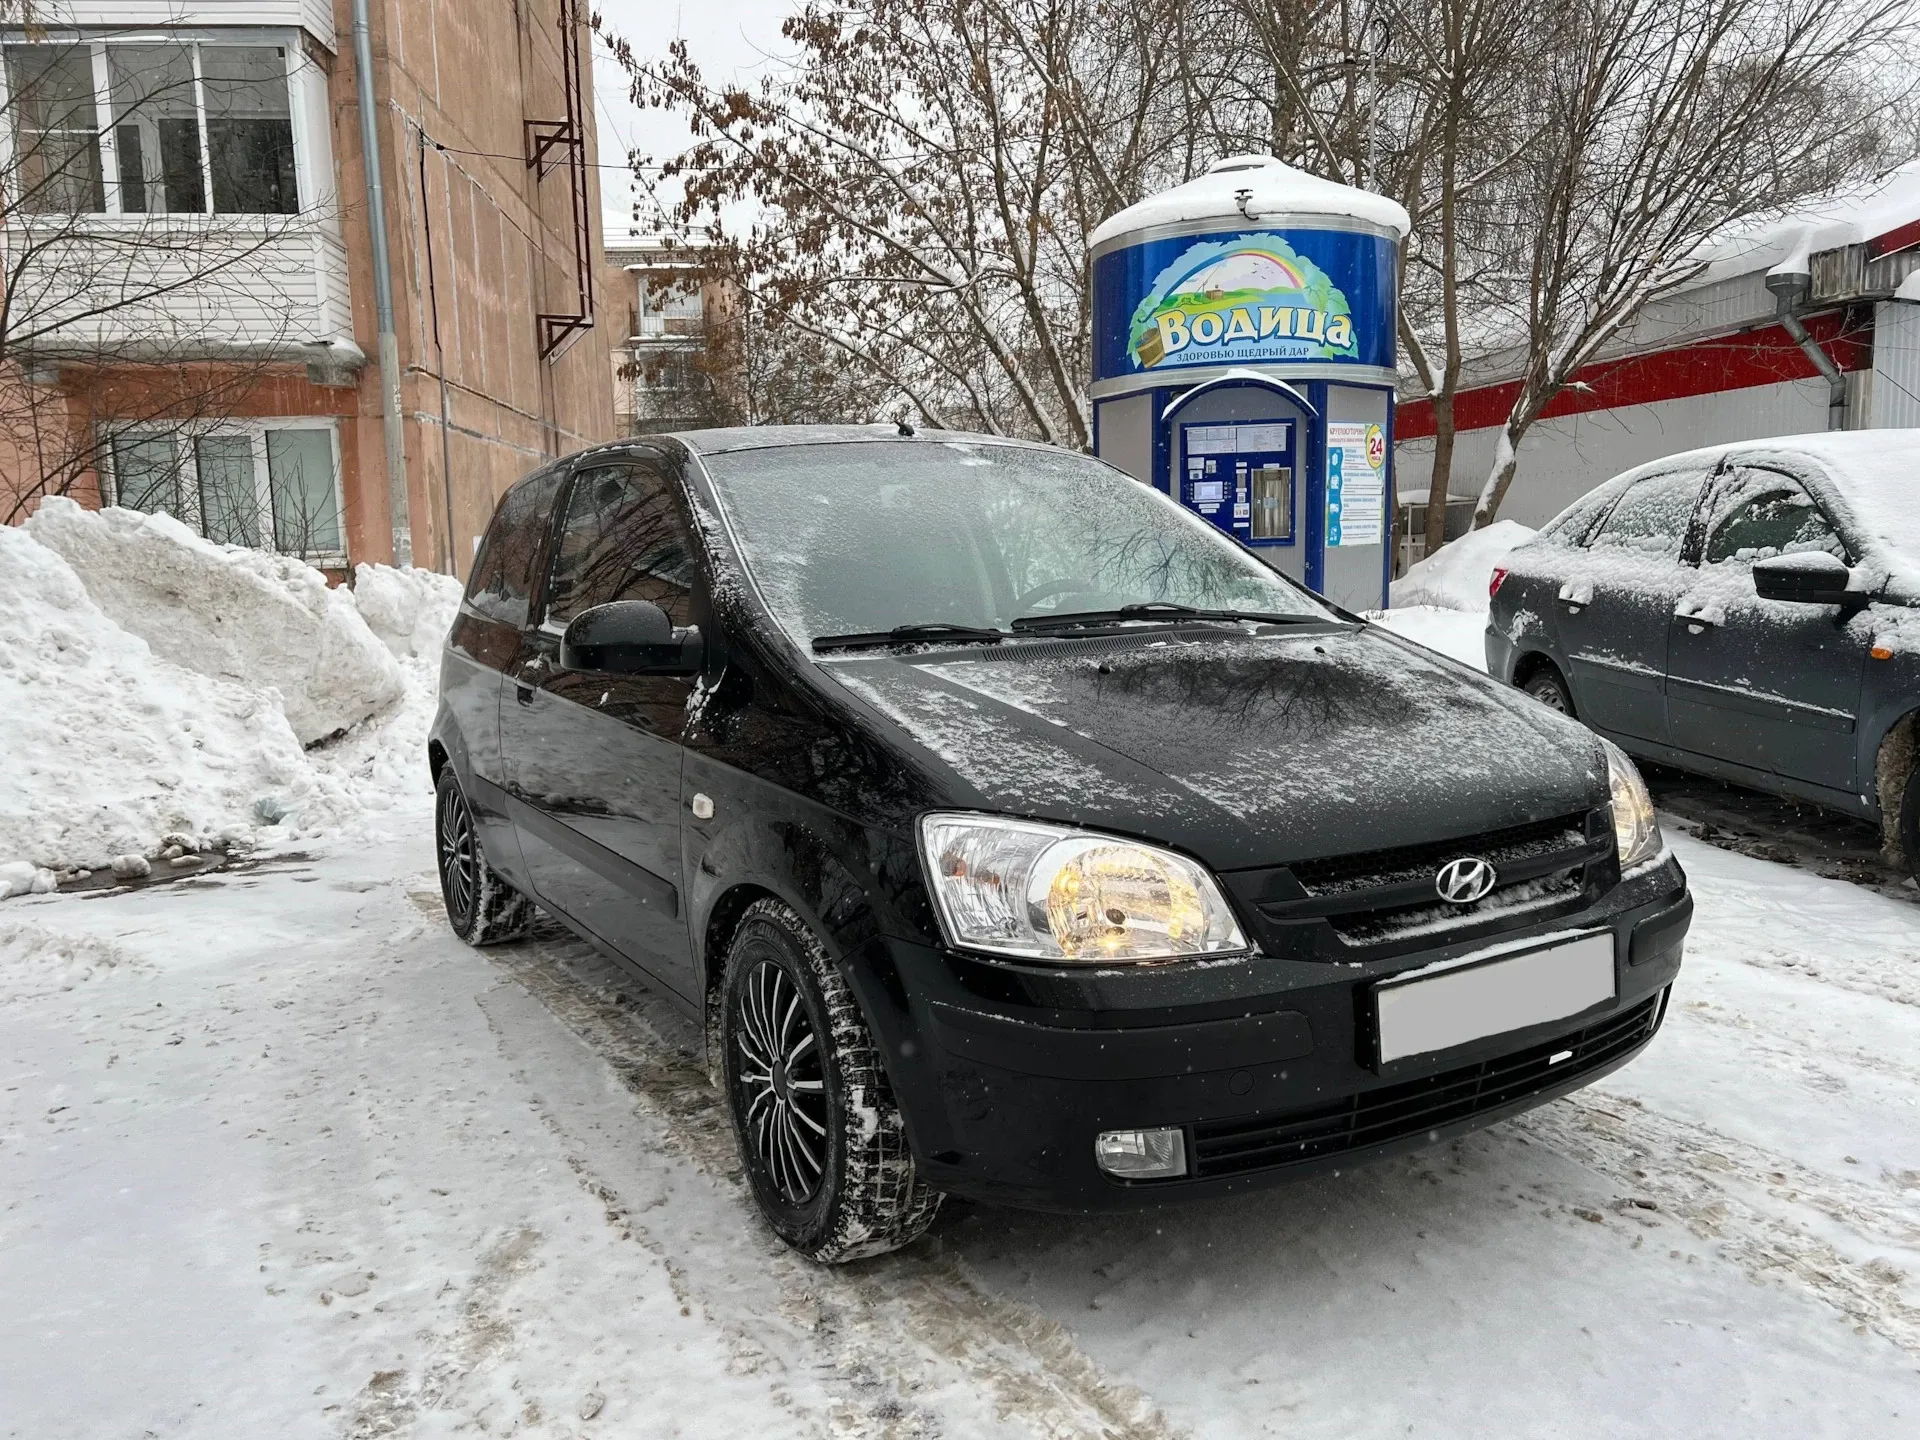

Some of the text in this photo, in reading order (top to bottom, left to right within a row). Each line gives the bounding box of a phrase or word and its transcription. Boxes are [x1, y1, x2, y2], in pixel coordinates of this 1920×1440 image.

[1176, 345, 1309, 363] ЗДОРОВЬЮ ЩЕДРЫЙ ДАР
[1369, 438, 1383, 456] 24
